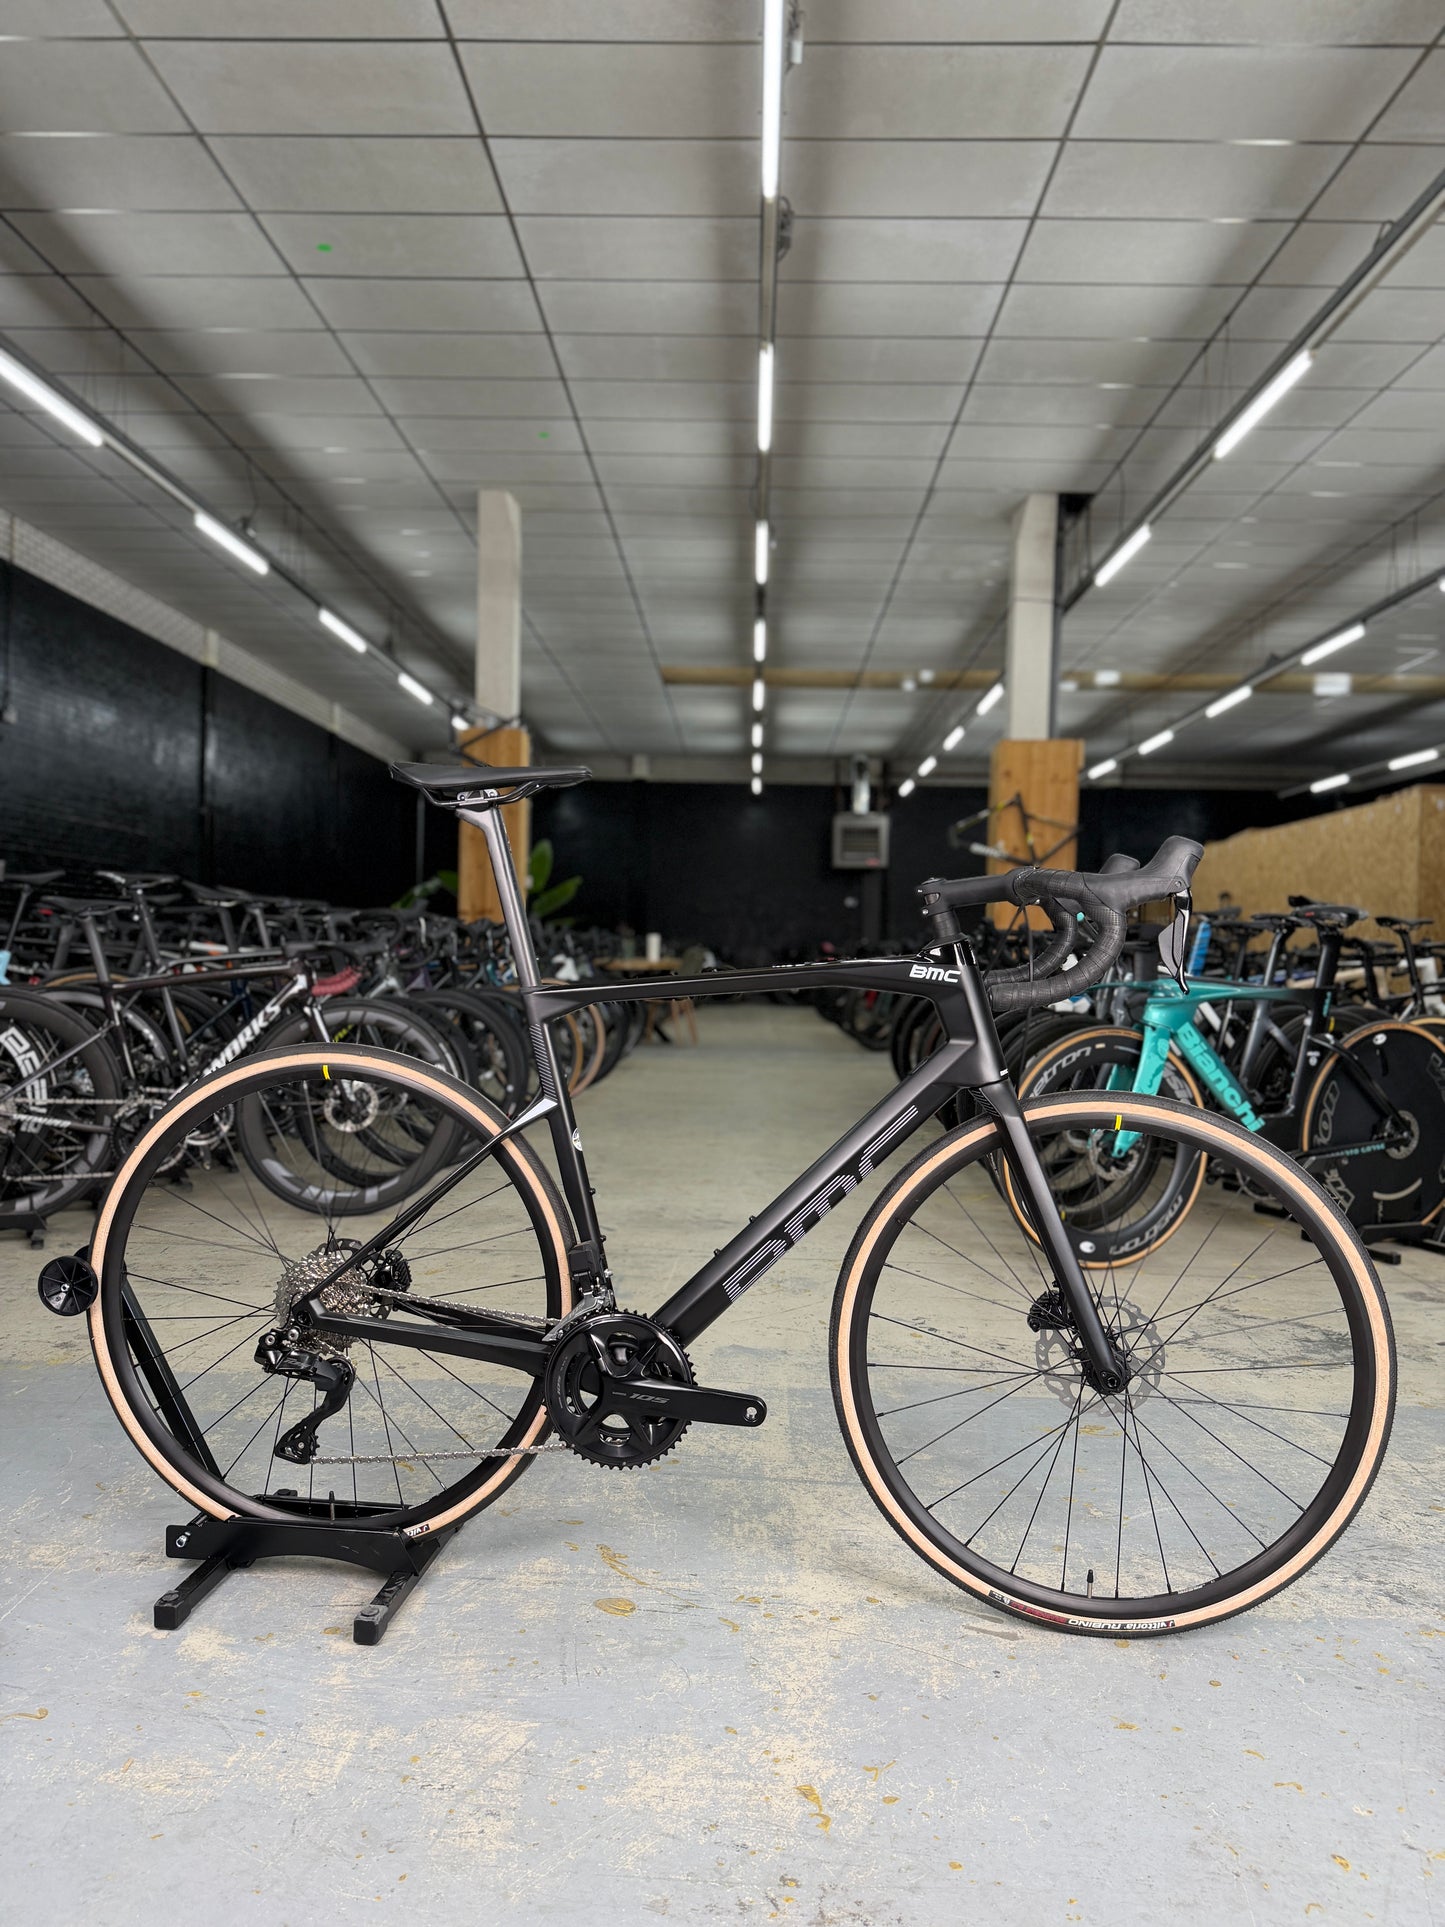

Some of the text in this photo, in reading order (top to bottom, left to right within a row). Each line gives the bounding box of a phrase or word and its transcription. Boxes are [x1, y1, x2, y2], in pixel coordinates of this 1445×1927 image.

[909, 964, 961, 983] BMC
[204, 1003, 280, 1077] WORKS
[1030, 1044, 1092, 1098] etron
[1177, 1021, 1266, 1132] Bianchi
[1109, 1194, 1184, 1256] metron
[629, 1392, 670, 1404] 105
[1068, 1618, 1122, 1631] RUBINO
